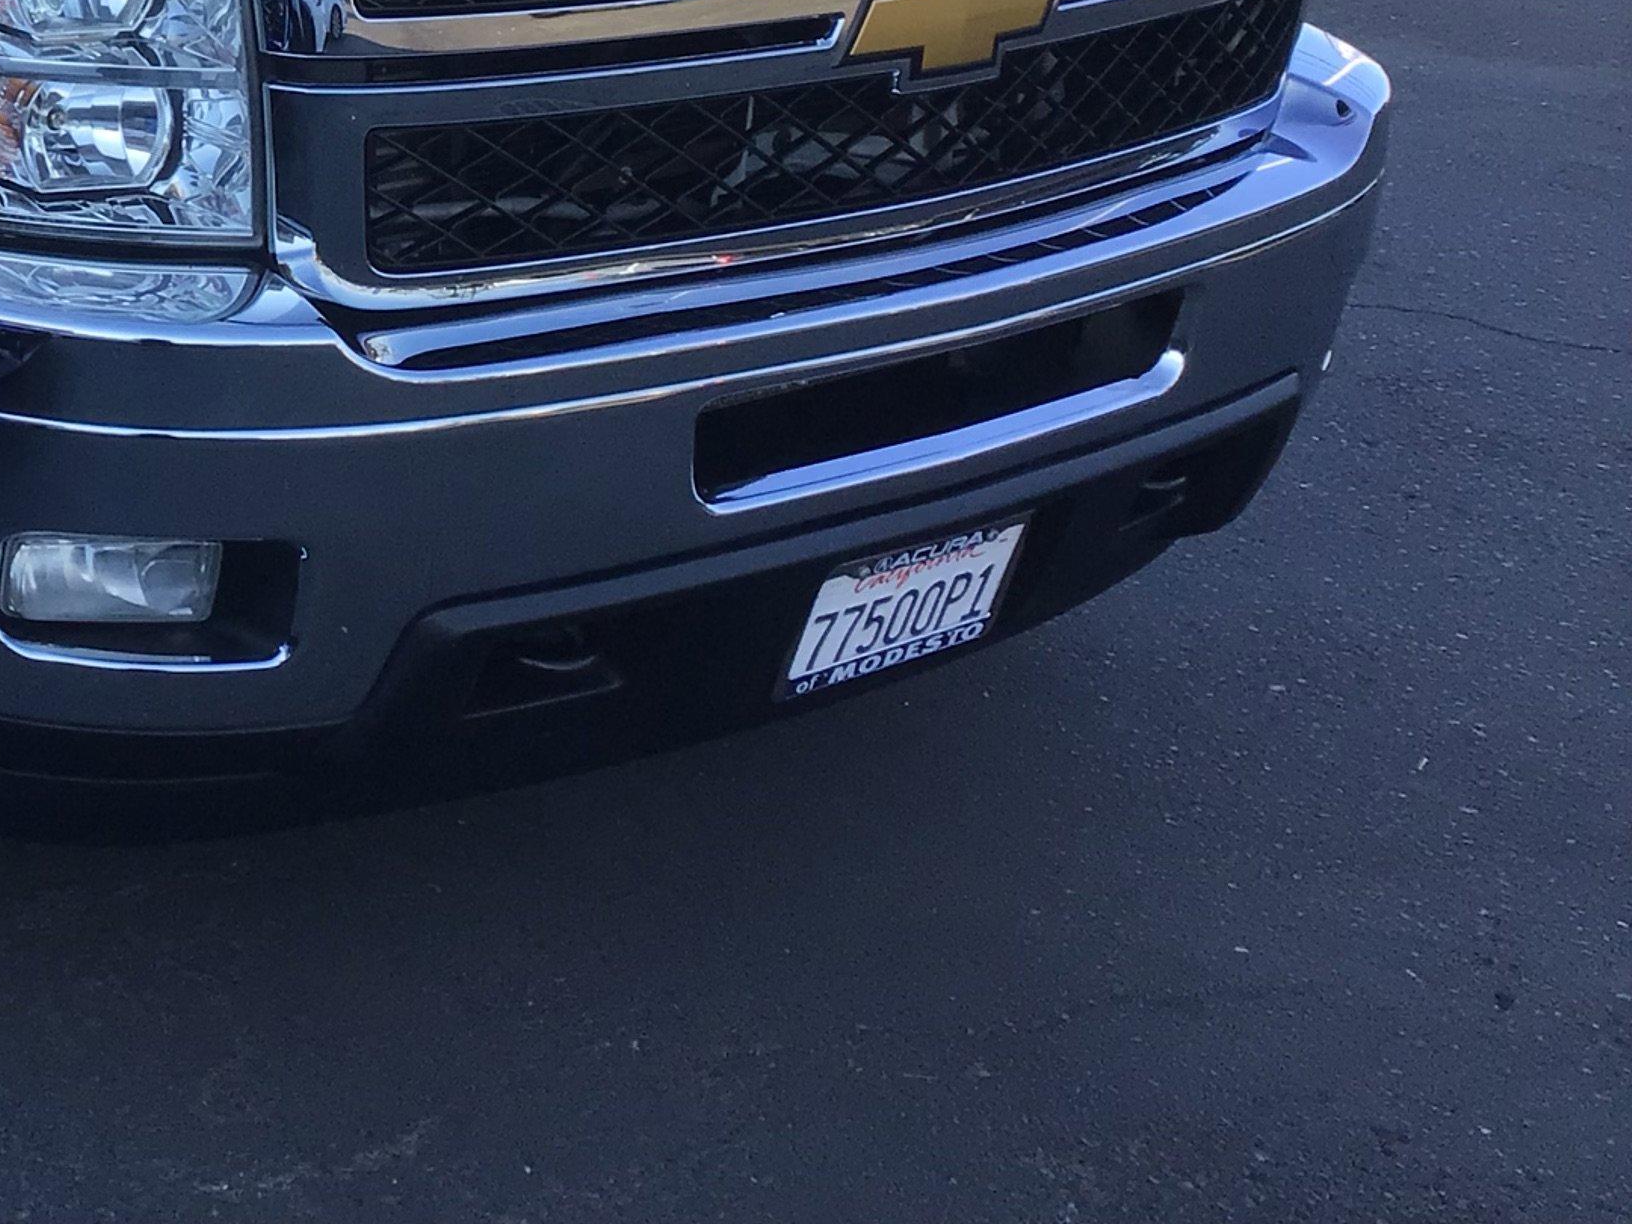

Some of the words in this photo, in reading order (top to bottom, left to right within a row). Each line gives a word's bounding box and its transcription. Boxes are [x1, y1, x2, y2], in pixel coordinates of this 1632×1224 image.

[893, 531, 984, 568] ACURA
[805, 564, 995, 672] 77500P1
[828, 622, 985, 685] MODESTO
